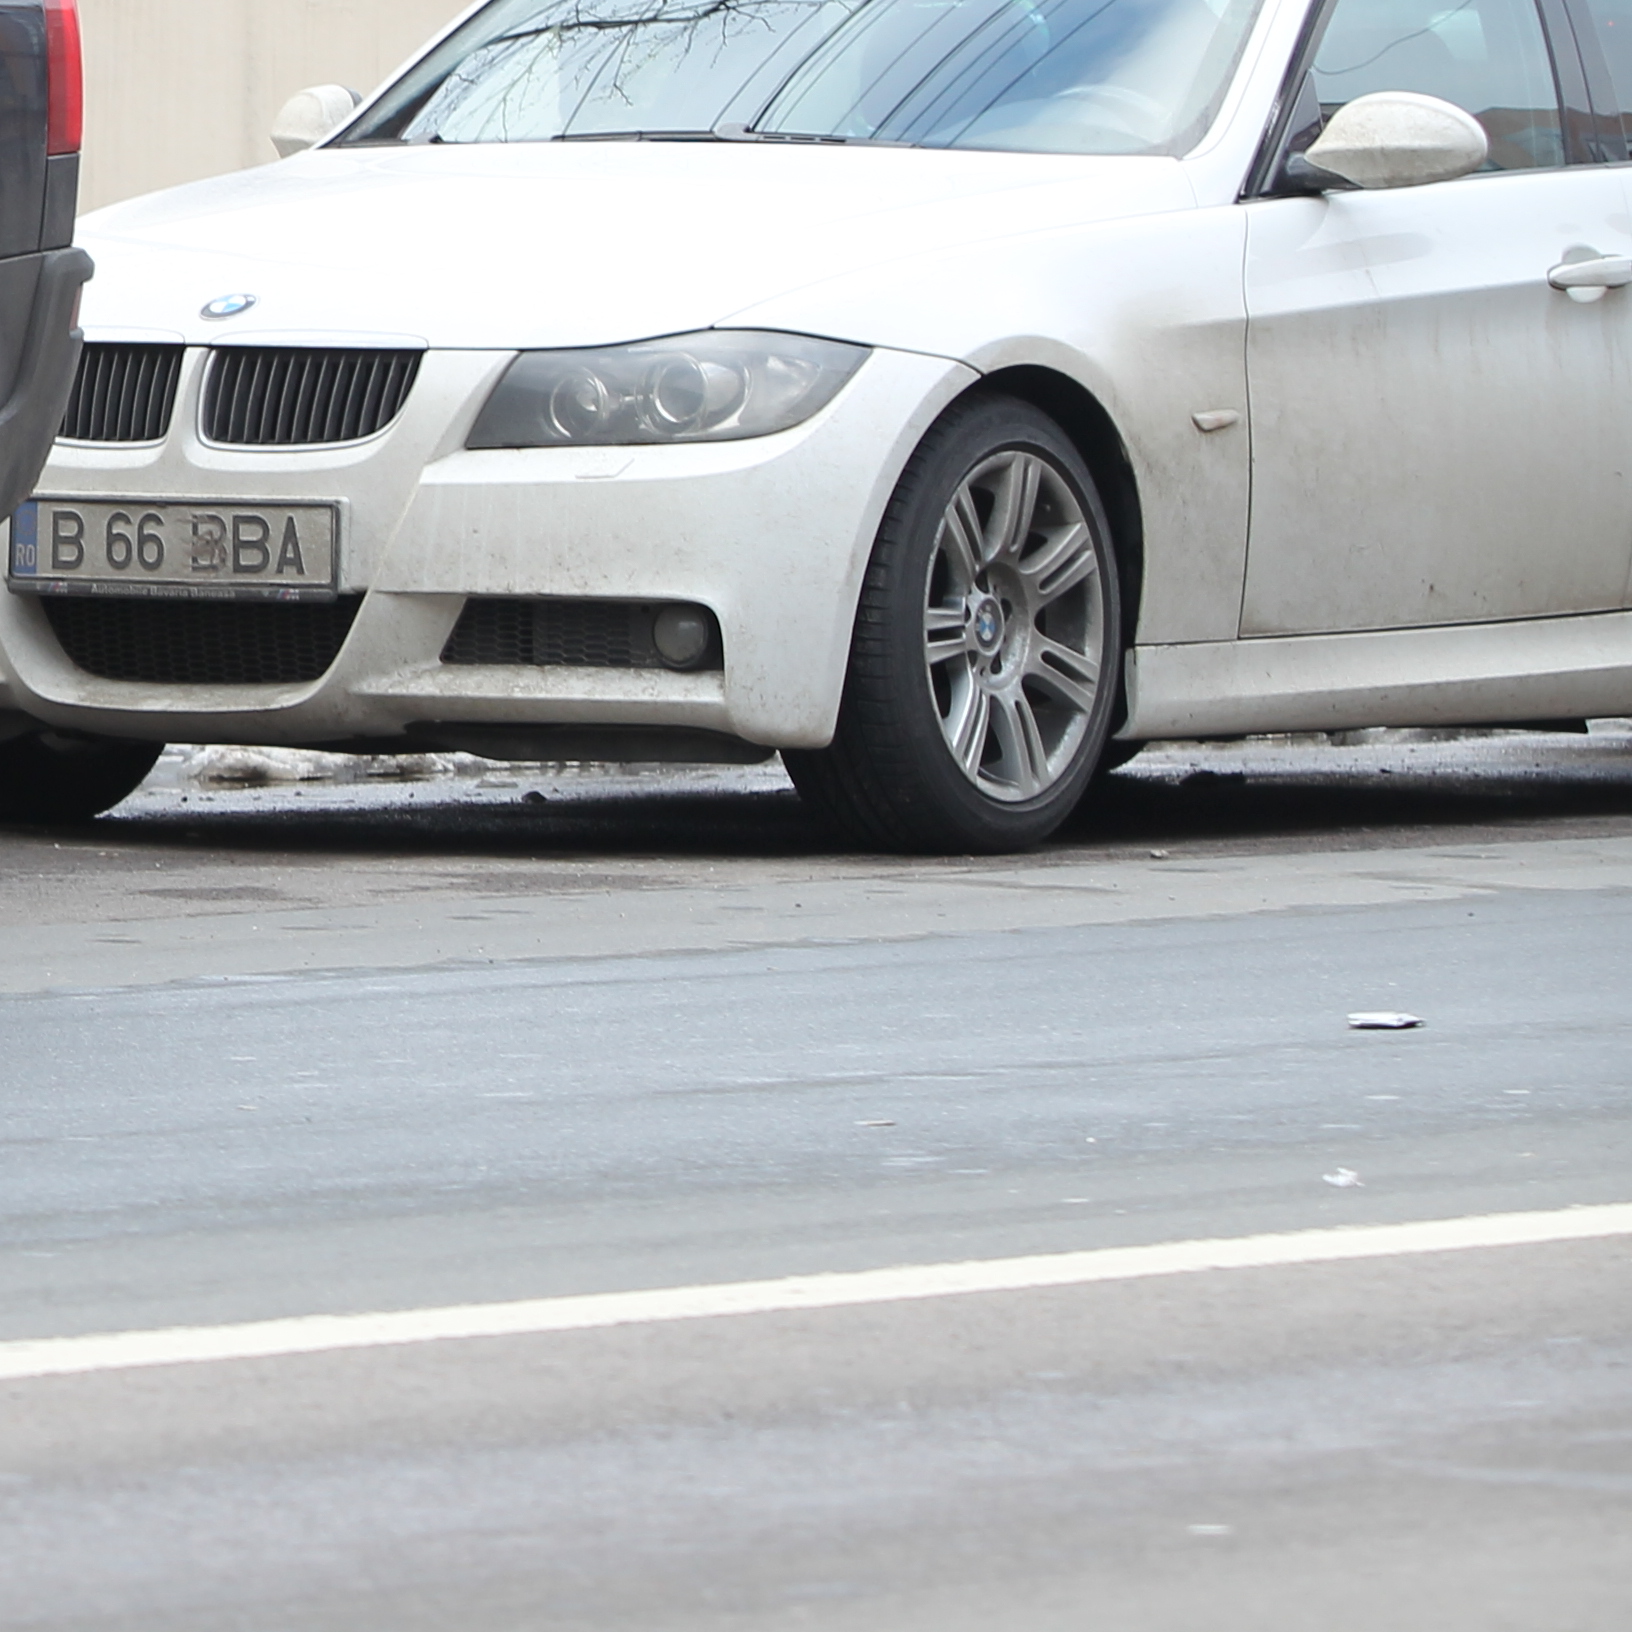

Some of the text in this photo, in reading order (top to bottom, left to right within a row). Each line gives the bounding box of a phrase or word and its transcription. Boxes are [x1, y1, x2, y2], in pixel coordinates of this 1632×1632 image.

[15, 542, 35, 567] RO
[51, 510, 85, 570] B
[105, 511, 165, 571] 66
